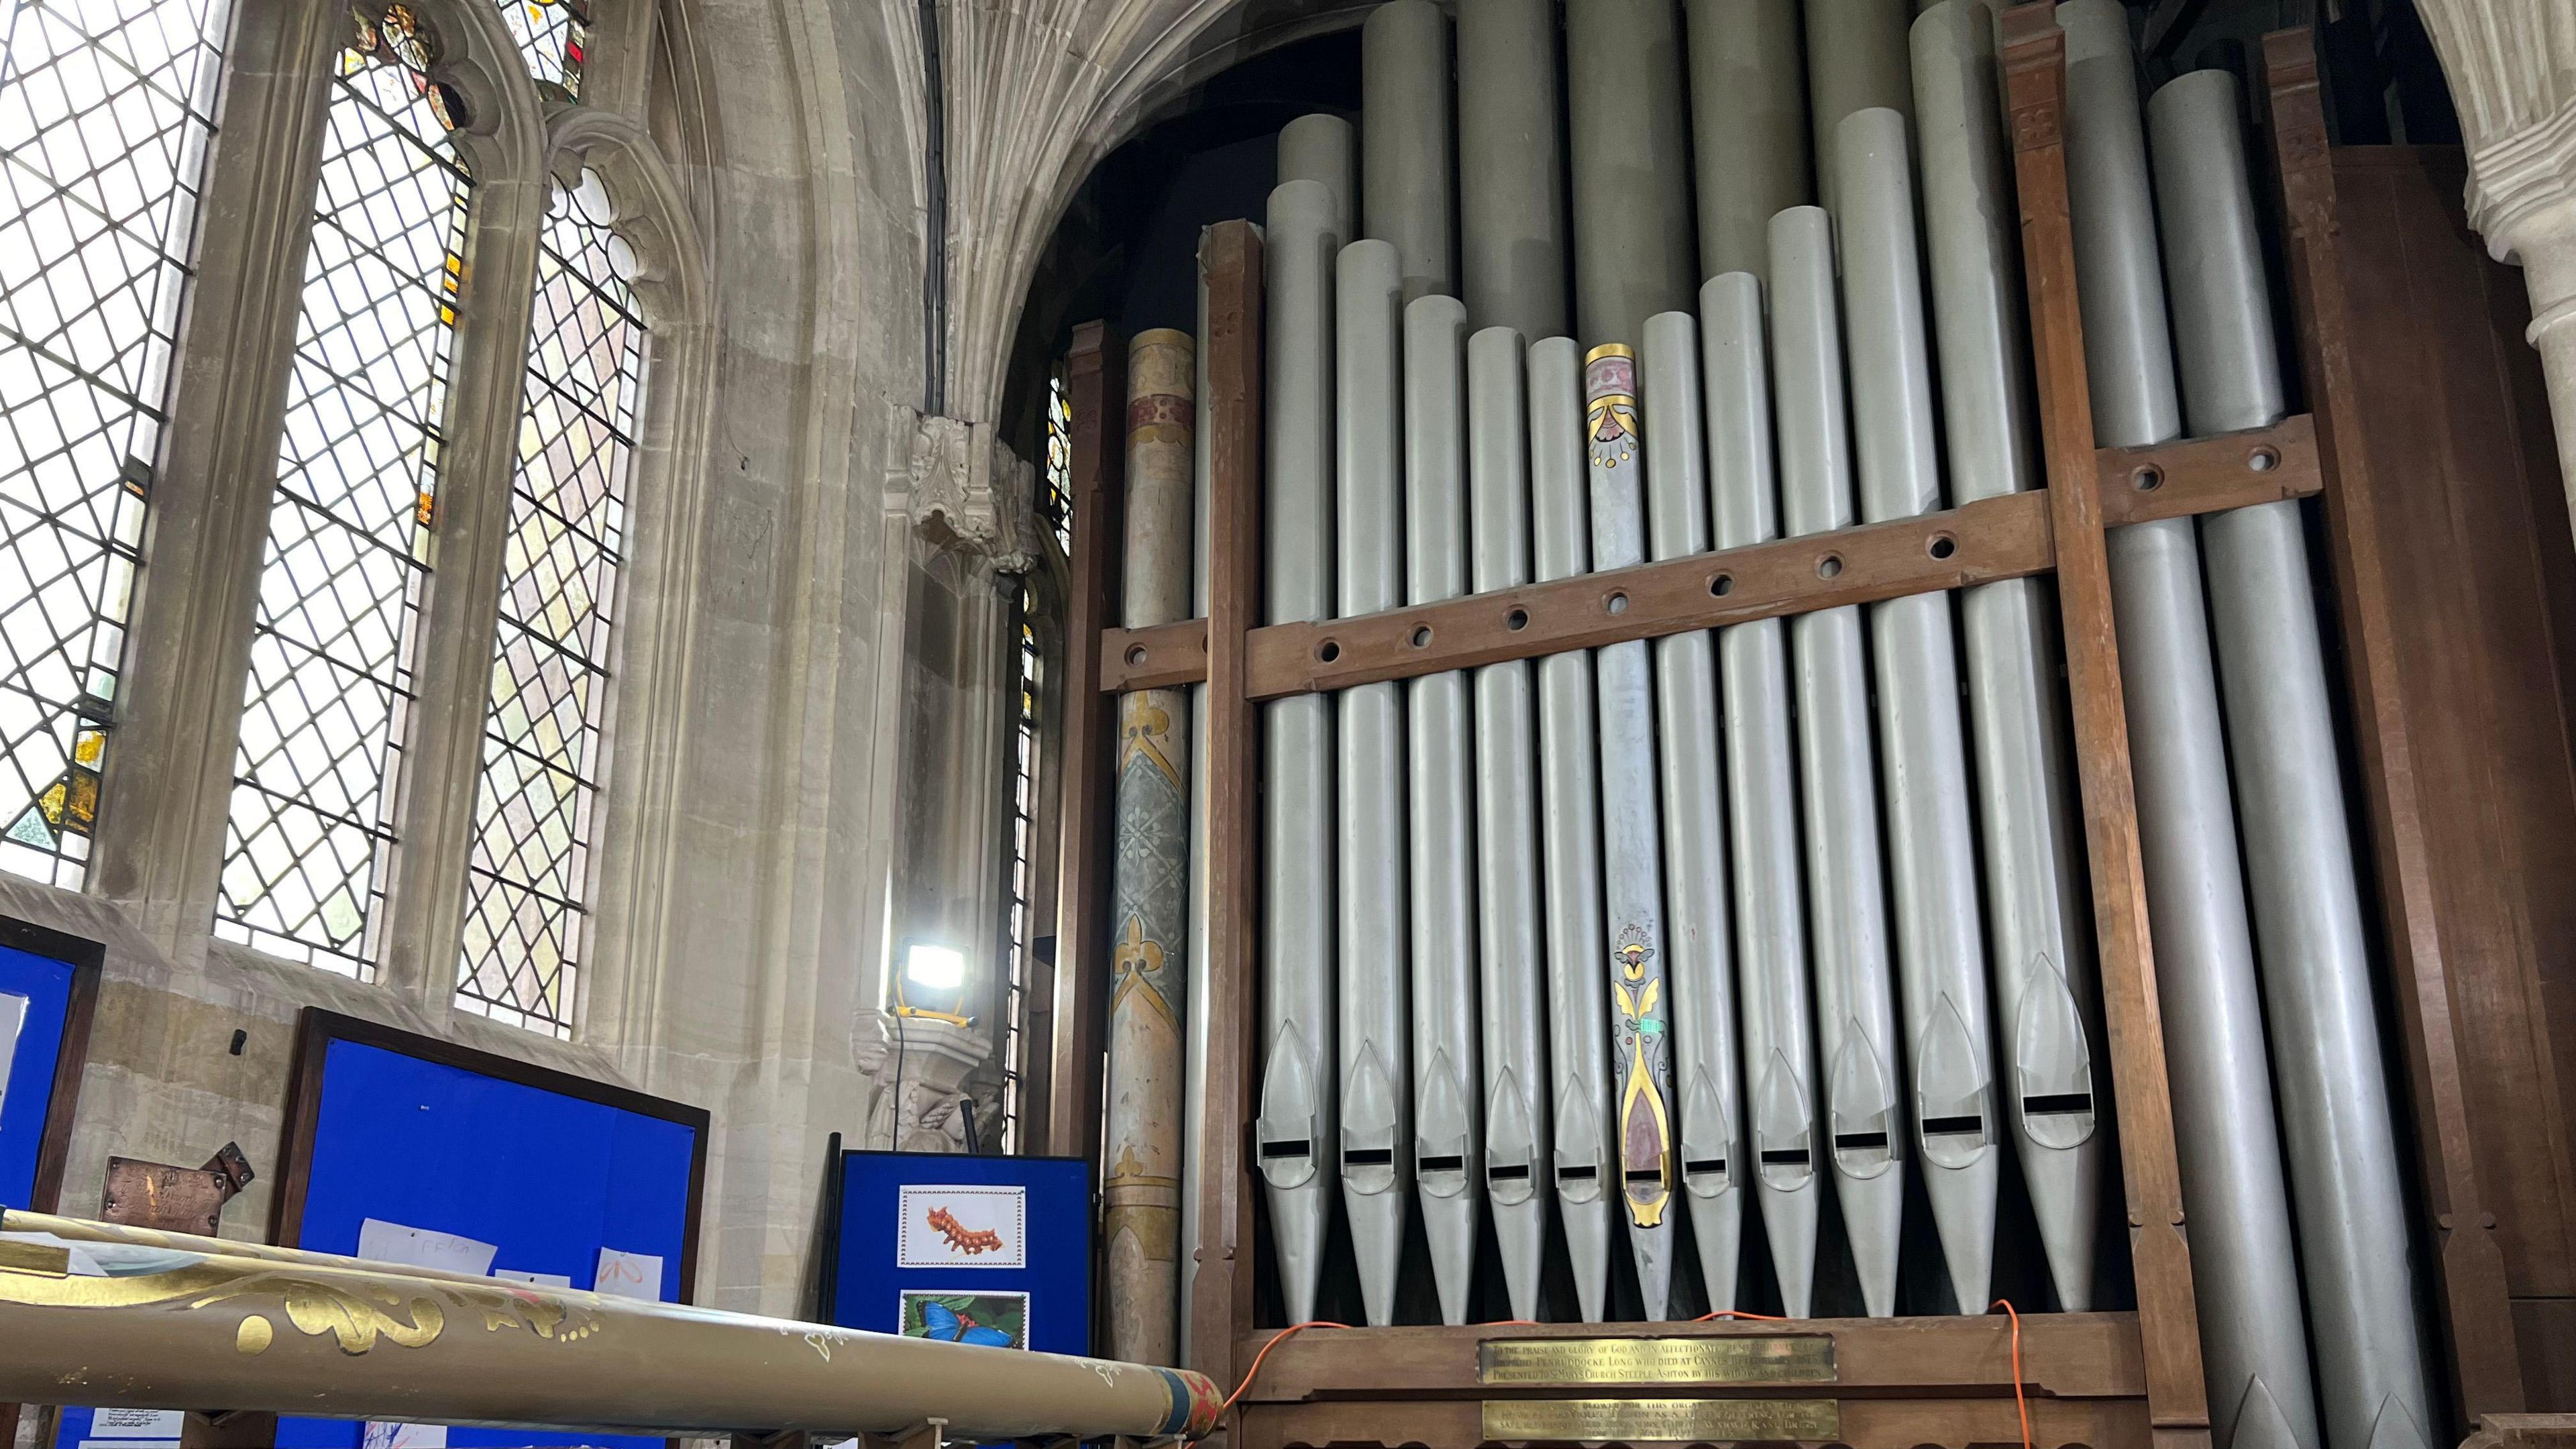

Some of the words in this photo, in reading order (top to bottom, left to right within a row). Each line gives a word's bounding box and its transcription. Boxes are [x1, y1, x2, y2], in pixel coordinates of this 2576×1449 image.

[1493, 1346, 1503, 1354] TO
[1523, 1346, 1548, 1354] PRAISE
[1611, 1344, 1627, 1353] GOD
[1661, 1344, 1719, 1353] AFFECTIONATE
[1537, 1357, 1605, 1366] PENRUDDOCKE
[1609, 1356, 1633, 1366] LONG
[1635, 1358, 1655, 1366] WHO
[1658, 1358, 1677, 1366] DIED
[1493, 1369, 1538, 1380] PRESENTED
[1540, 1371, 1549, 1379] TO
[1585, 1369, 1615, 1379] CHURCH
[1618, 1368, 1652, 1379] STEEPLE
[1658, 1368, 1689, 1378] ASHTON
[1693, 1370, 1702, 1378] BY
[1706, 1369, 1719, 1378] HIS
